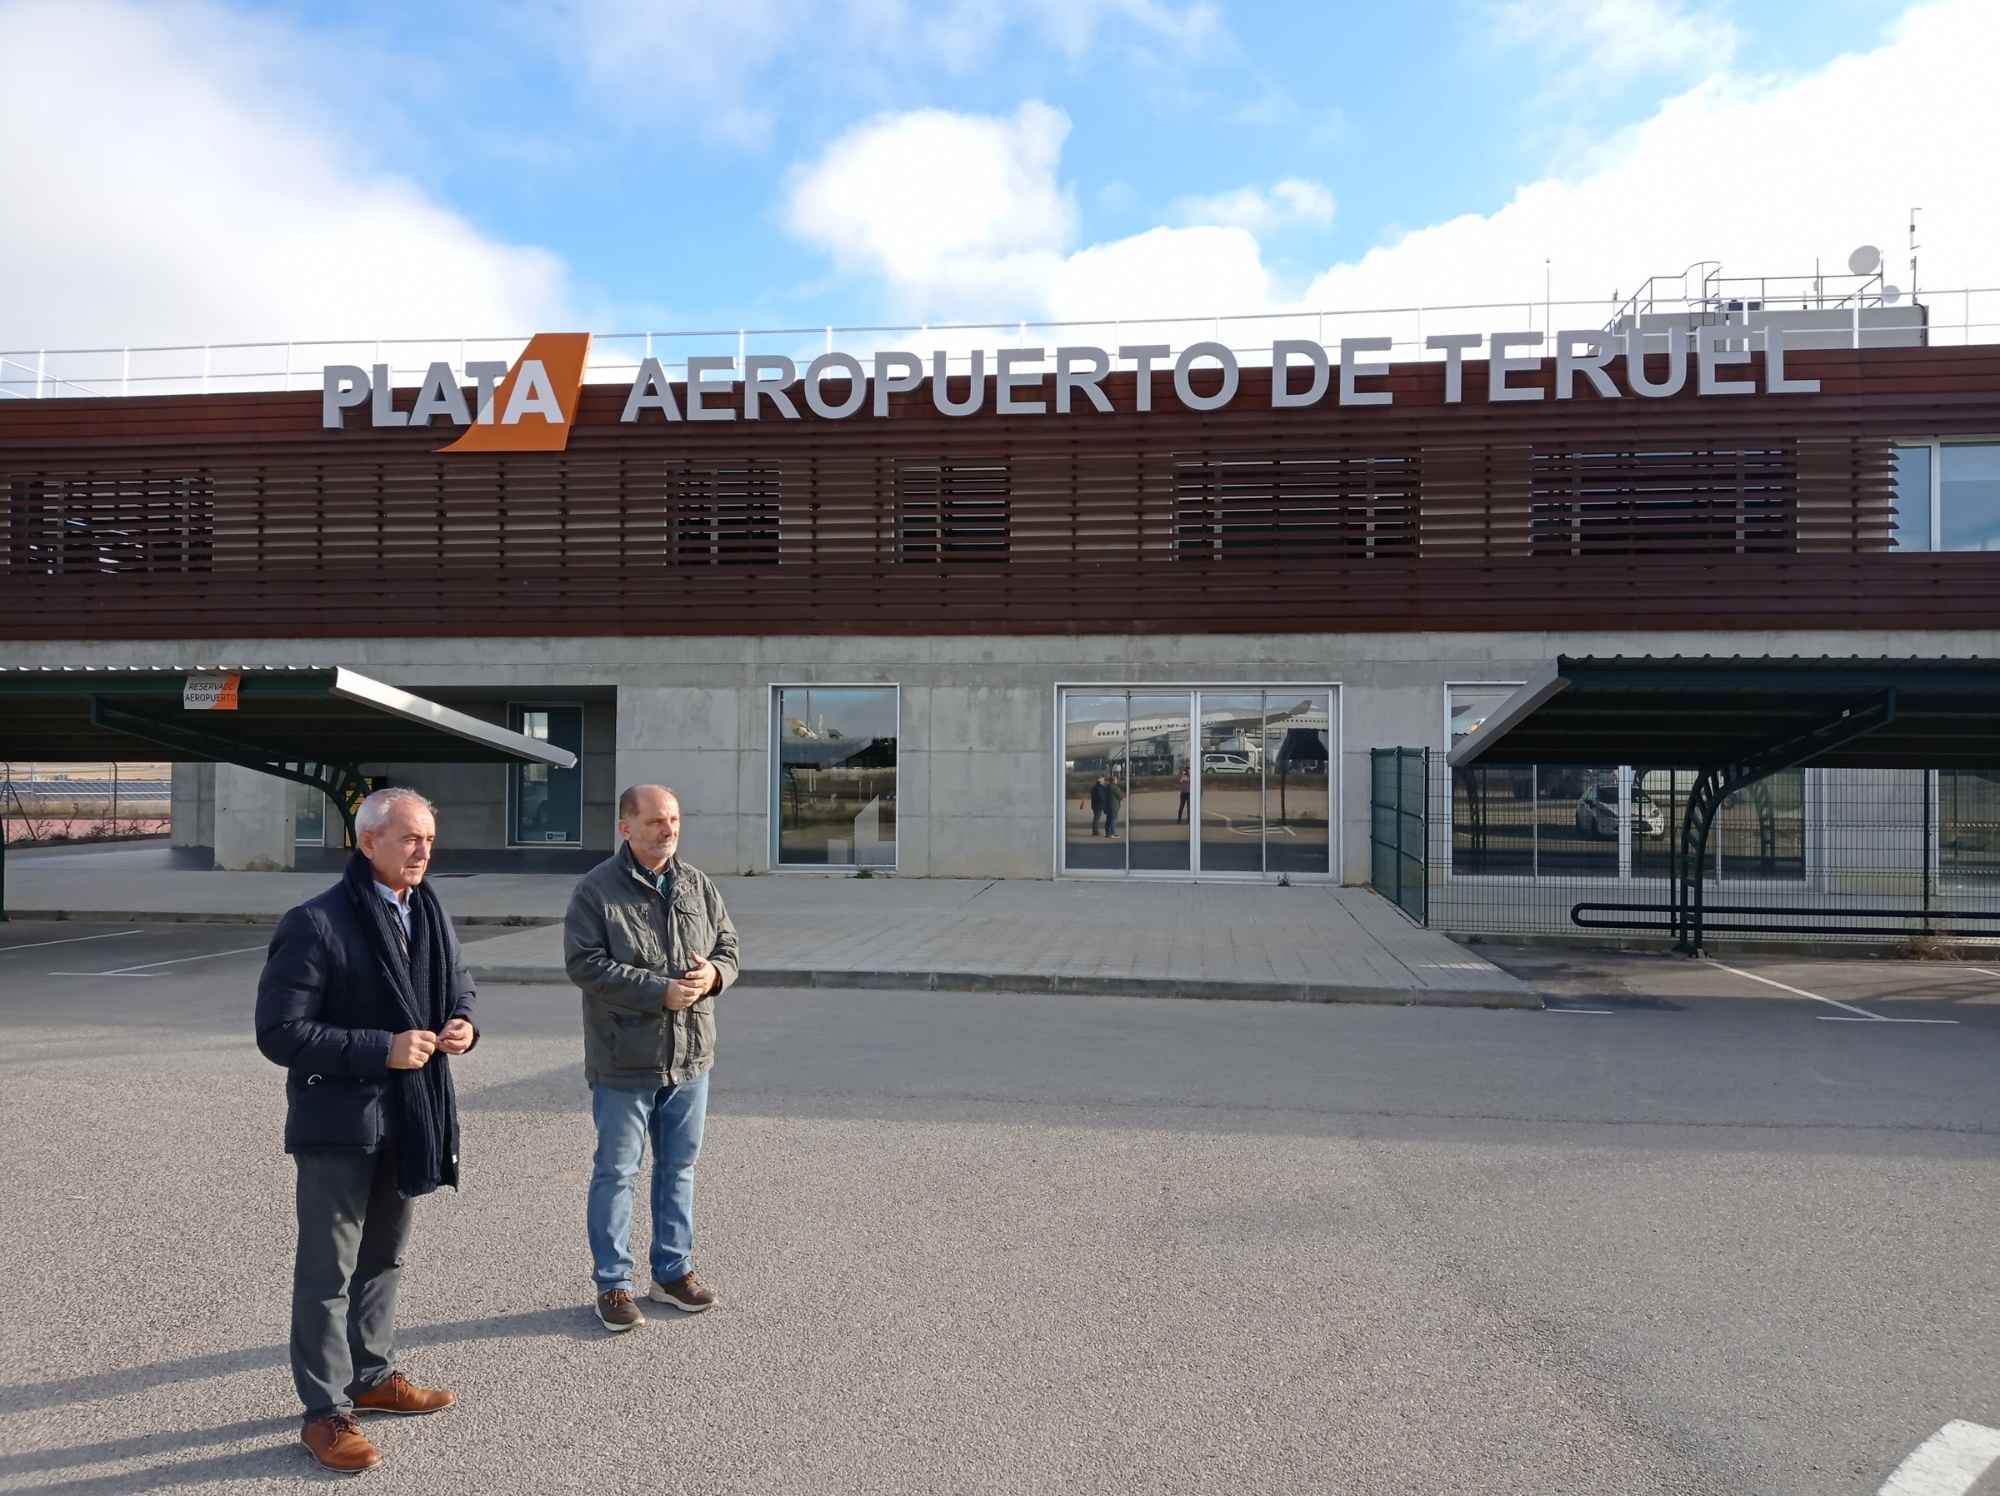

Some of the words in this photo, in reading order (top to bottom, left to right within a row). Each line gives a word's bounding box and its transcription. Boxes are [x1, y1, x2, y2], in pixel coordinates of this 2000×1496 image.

[322, 359, 566, 429] PLATA
[620, 345, 1240, 421] AEROPUERTO
[1270, 337, 1393, 409] DE
[1426, 326, 1822, 402] TERUEL
[184, 693, 237, 703] AEROPUERTO
